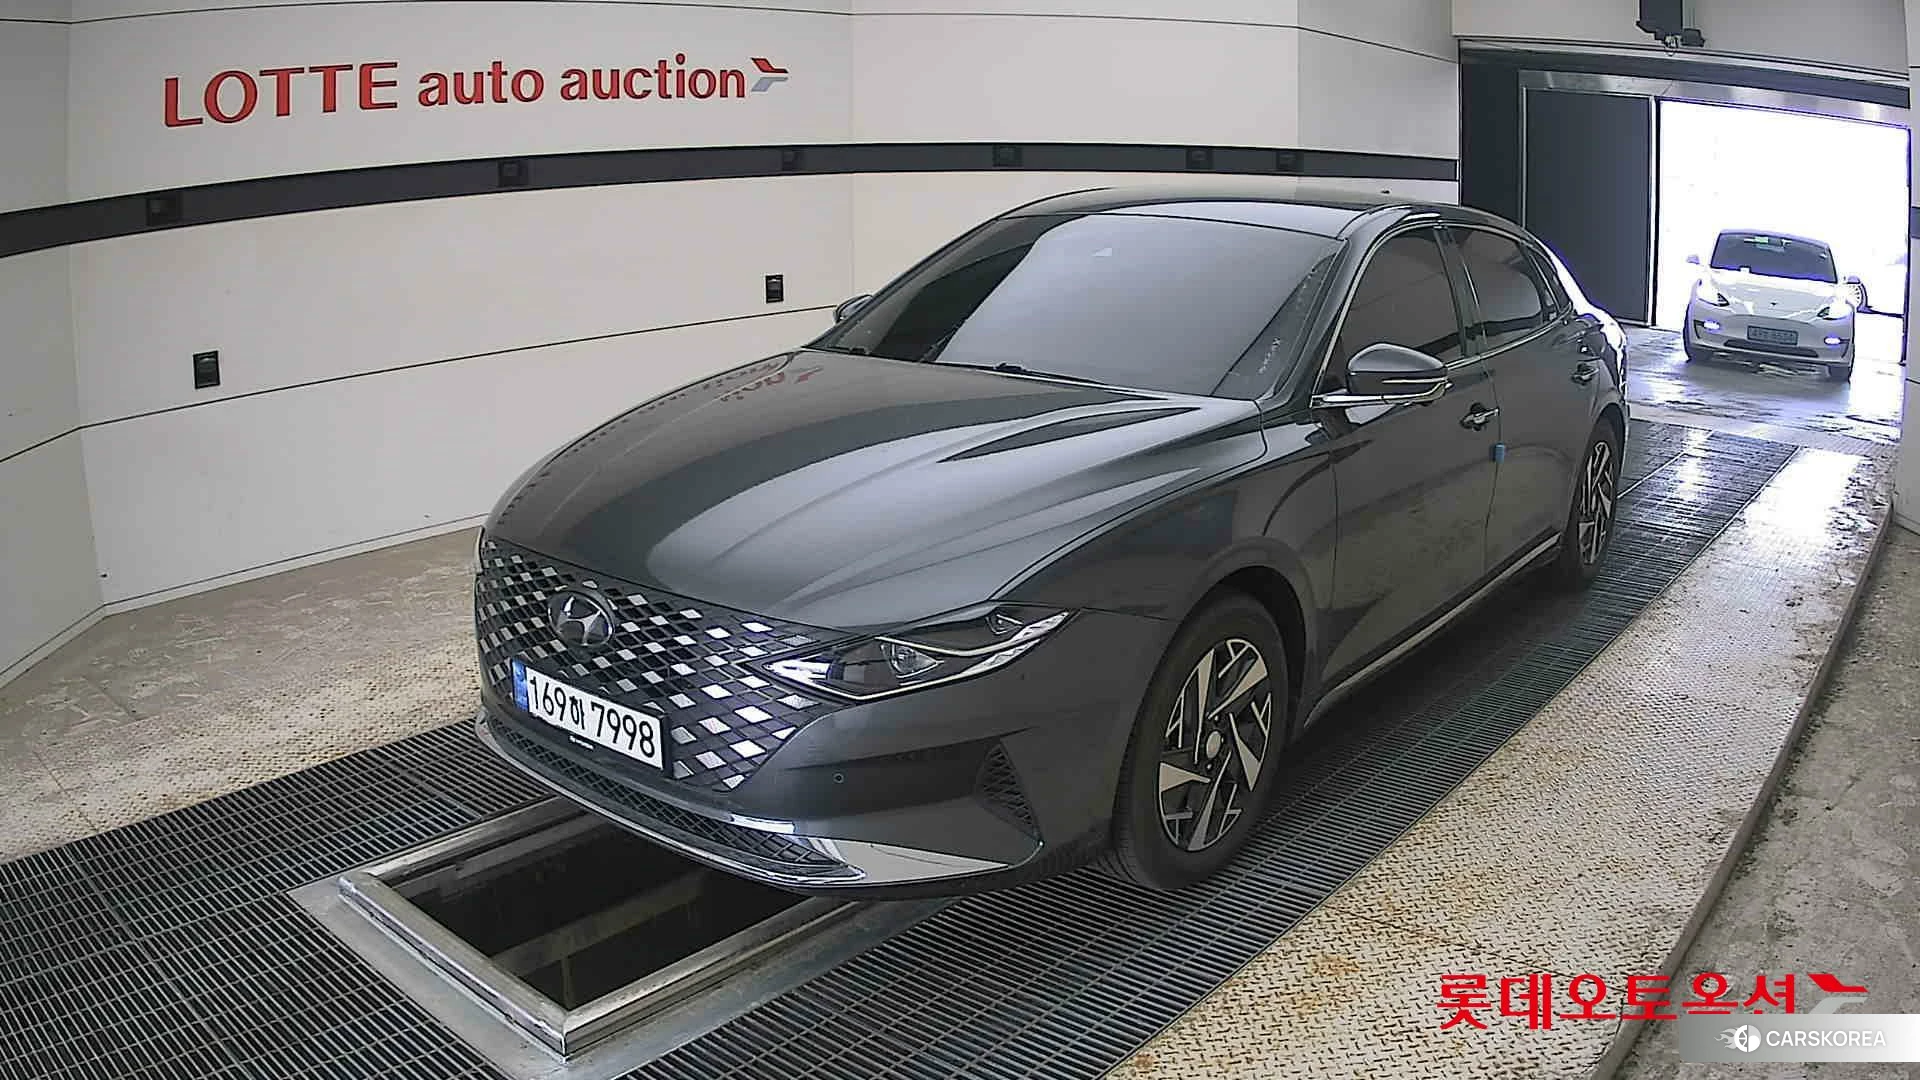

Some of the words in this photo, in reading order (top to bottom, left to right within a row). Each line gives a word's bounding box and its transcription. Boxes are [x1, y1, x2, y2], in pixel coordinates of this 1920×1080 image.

[164, 62, 399, 127] LOTTE
[418, 61, 545, 107] auto
[560, 53, 746, 100] auction
[529, 675, 586, 731] 169하
[590, 701, 656, 759] 7998
